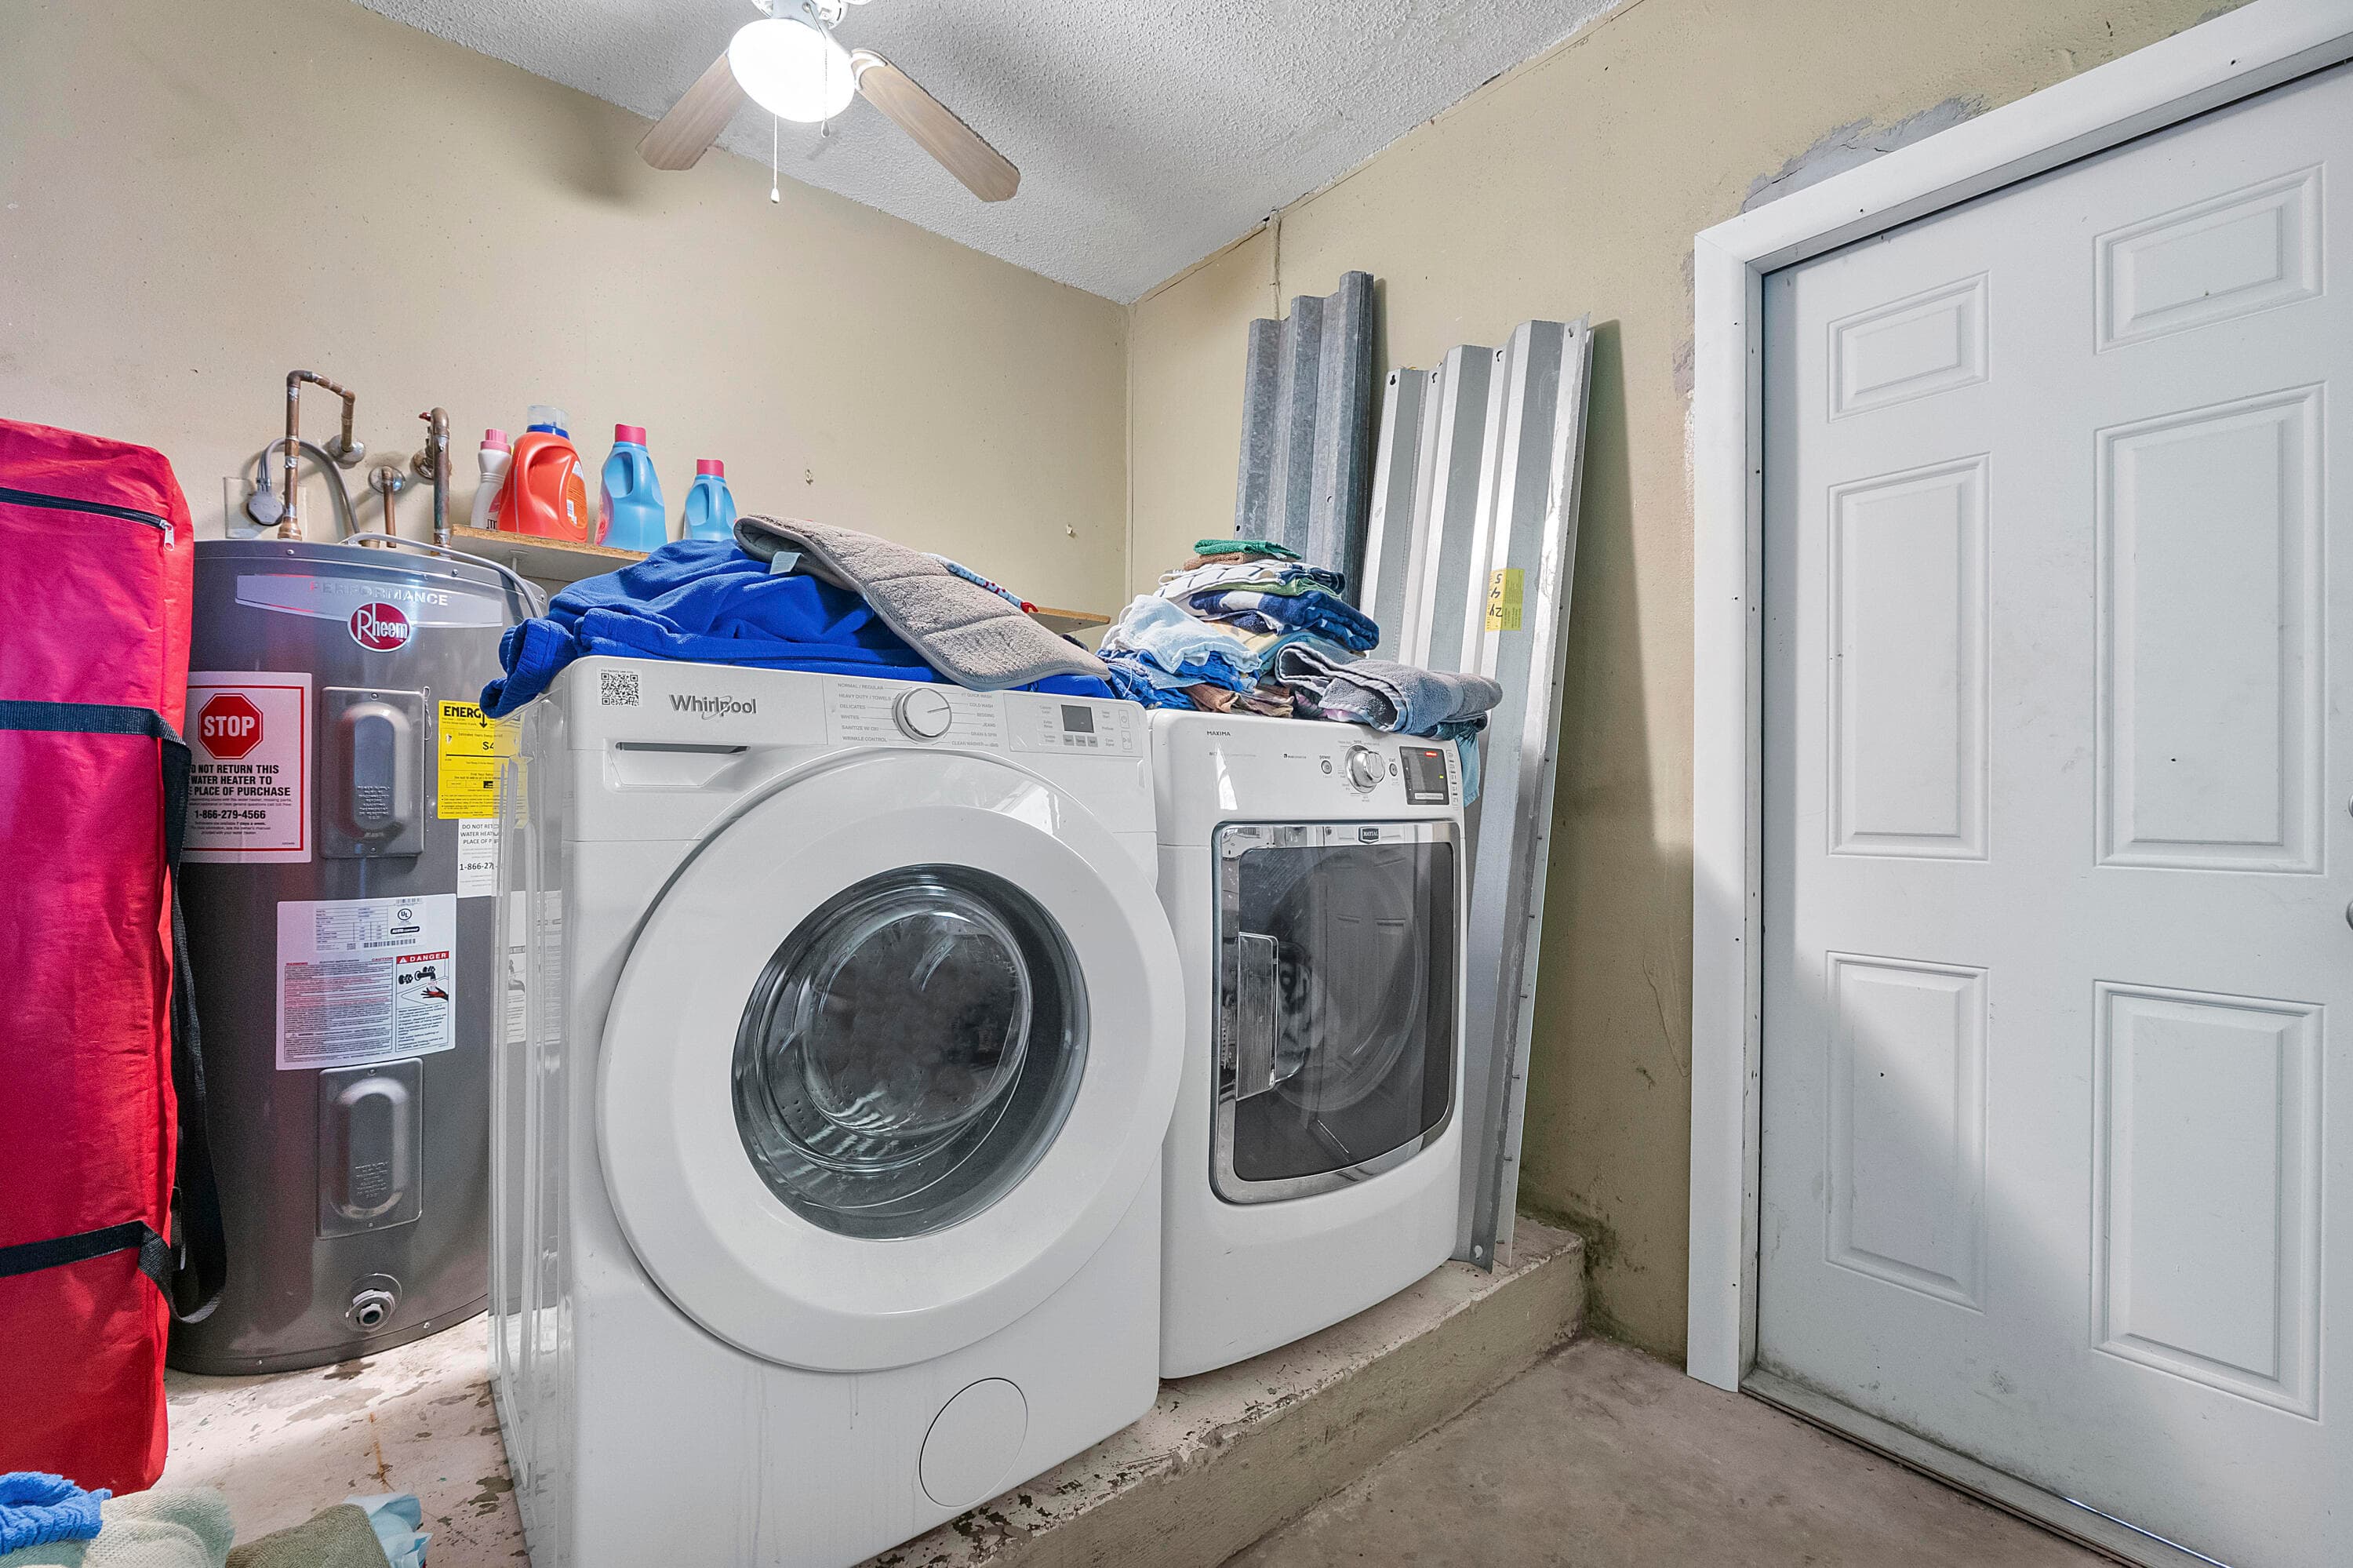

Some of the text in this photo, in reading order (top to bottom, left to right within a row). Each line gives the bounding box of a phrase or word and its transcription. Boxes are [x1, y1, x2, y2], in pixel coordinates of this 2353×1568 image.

[357, 602, 408, 643] Rheem
[669, 694, 757, 717] Whirlpool
[204, 715, 255, 737] STOP
[198, 765, 214, 773] NOT
[216, 765, 253, 773] RETURN
[256, 765, 279, 774] THIS
[191, 776, 272, 784] WATER HEATER TO
[195, 787, 220, 795] PLACE
[223, 787, 235, 795] OF
[237, 787, 291, 796] PURCHASE
[195, 809, 266, 819] 1-866-279-4566
[409, 952, 446, 962] DANGER
